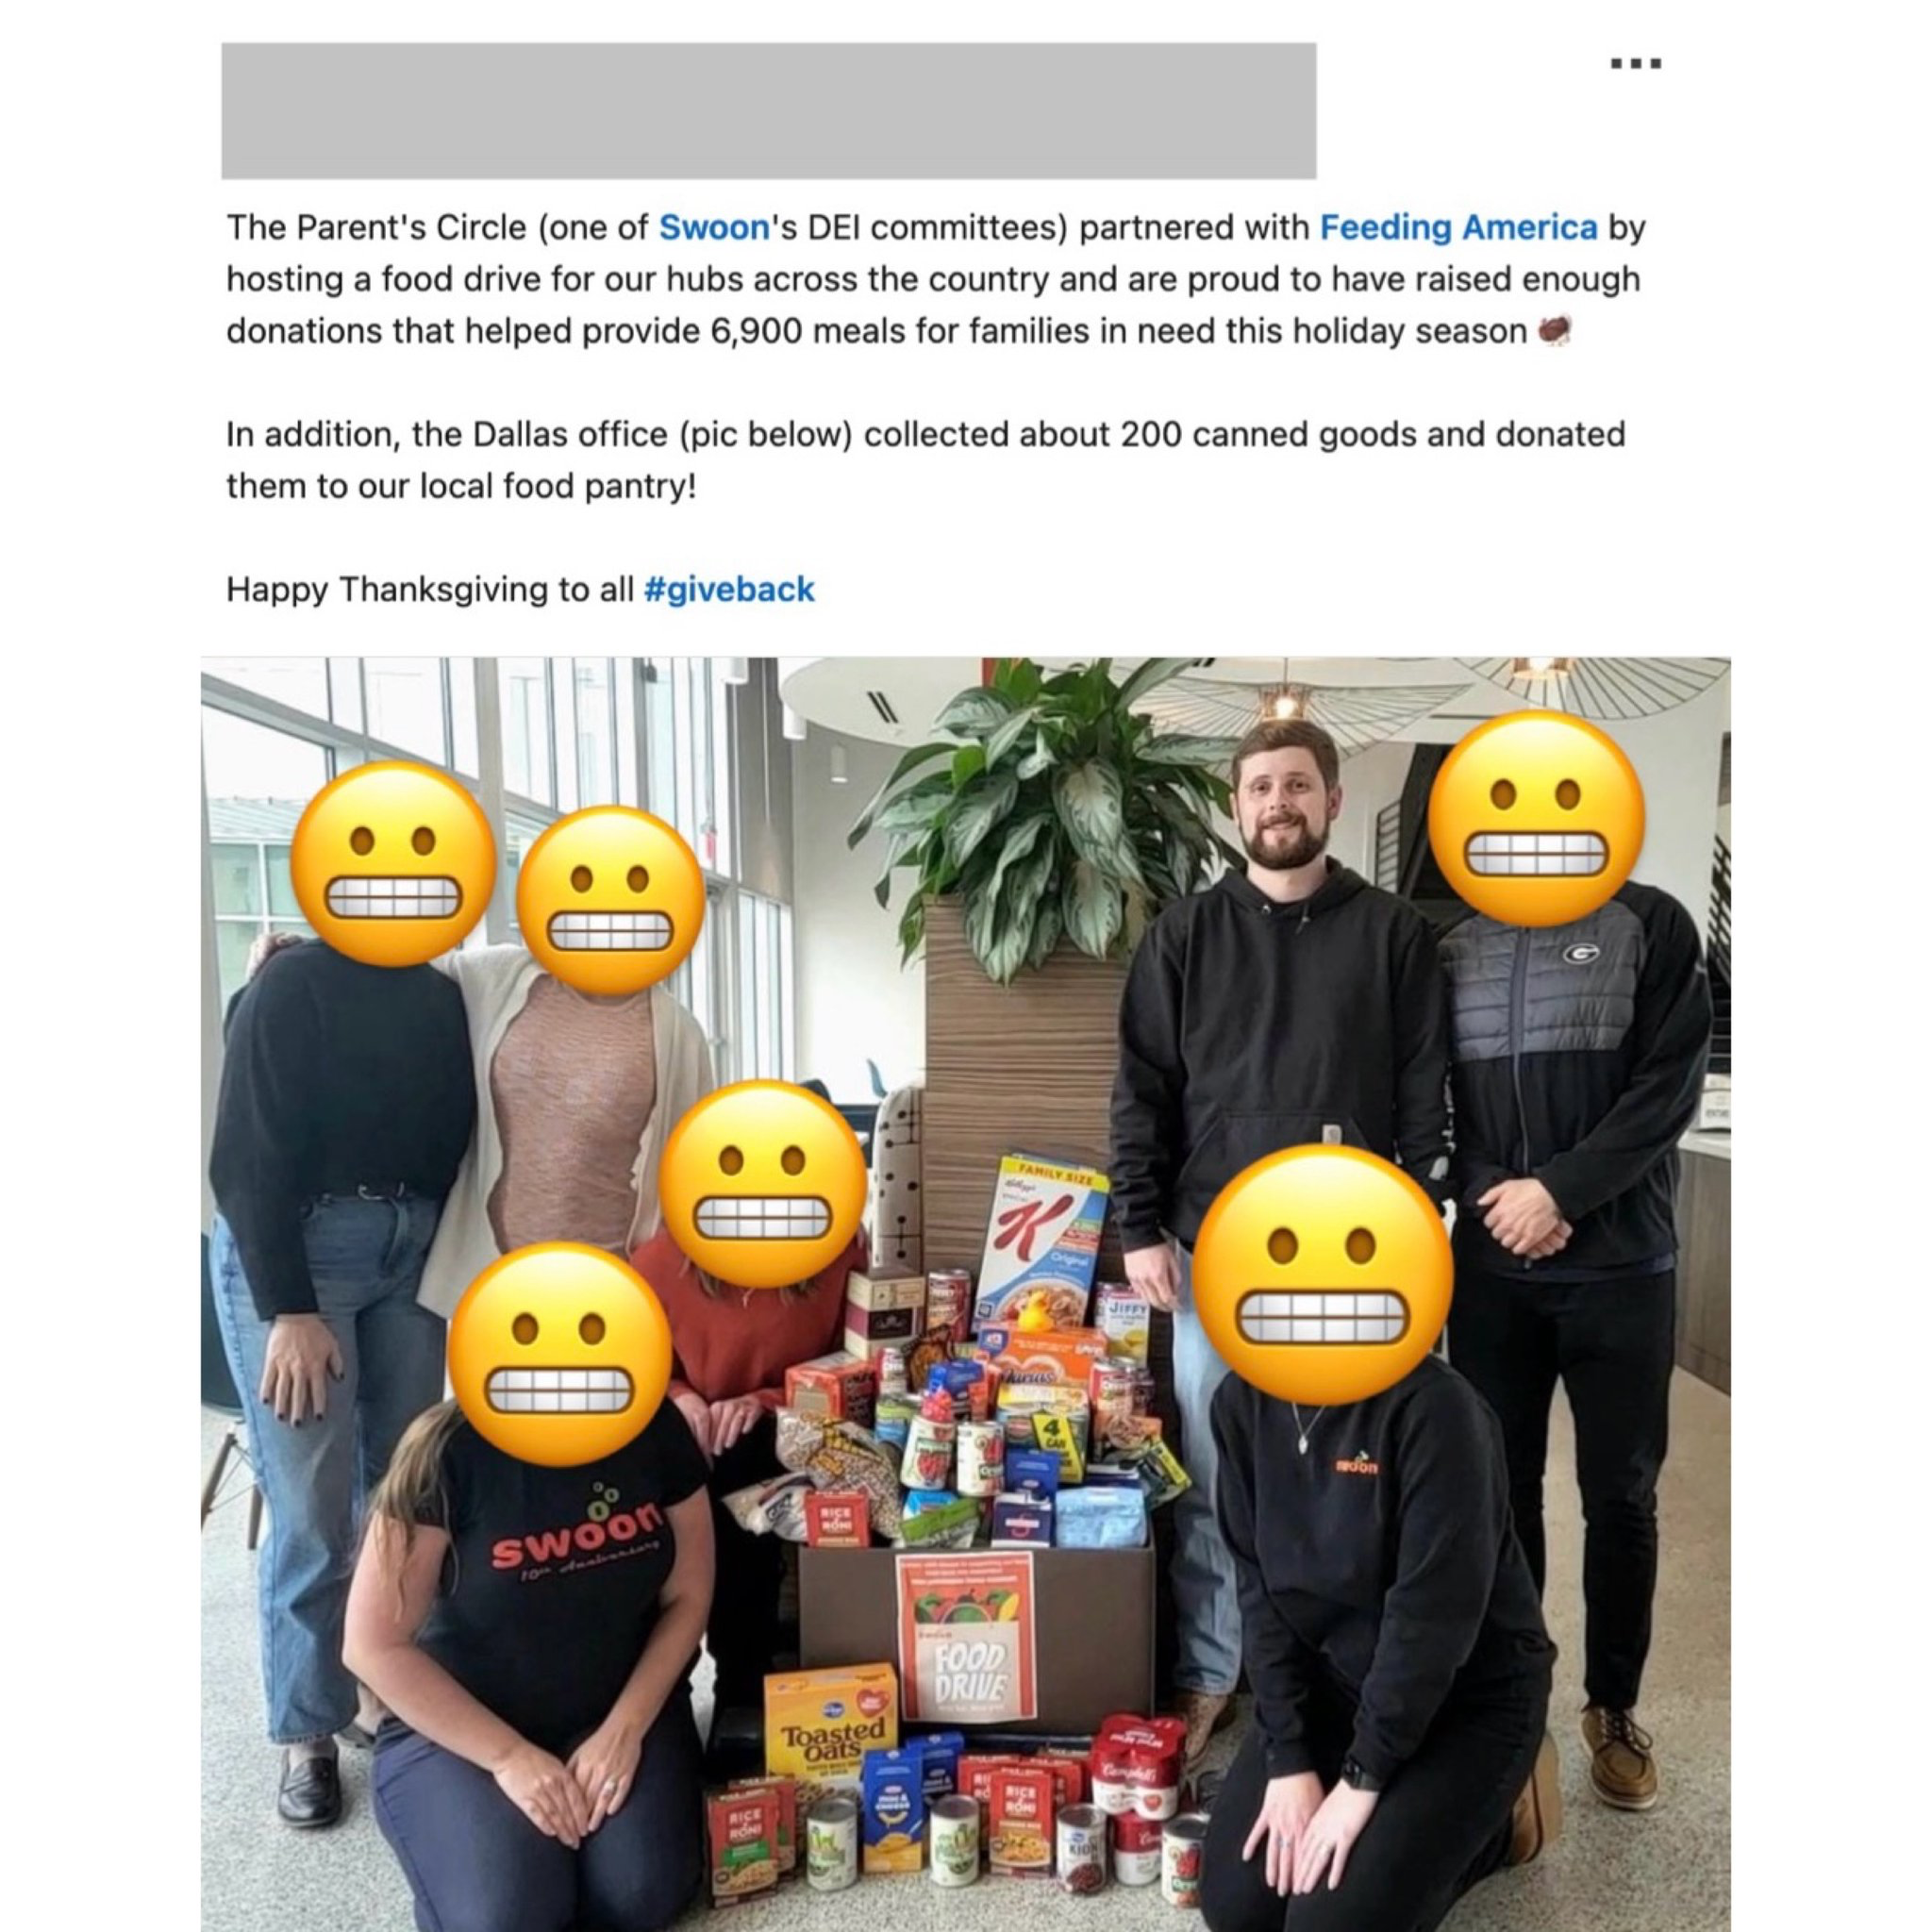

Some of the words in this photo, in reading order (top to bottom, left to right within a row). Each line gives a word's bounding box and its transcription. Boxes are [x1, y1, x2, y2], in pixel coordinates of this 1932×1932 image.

[1018, 1163, 1064, 1180] FAMILY
[1067, 1174, 1093, 1187] SIZE
[993, 1192, 1074, 1262] K
[1043, 1419, 1060, 1436] 4
[1045, 1437, 1067, 1449] CAN
[819, 1507, 853, 1519] RICE
[491, 1502, 664, 1571] swoon
[935, 1641, 1007, 1674] FOOD
[935, 1673, 1008, 1704] DRIVE
[780, 1717, 886, 1747] Toasted
[1005, 1785, 1037, 1796] RICE
[728, 1807, 762, 1825] RICE
[1005, 1801, 1037, 1813] RONI
[728, 1825, 762, 1840] RONI
